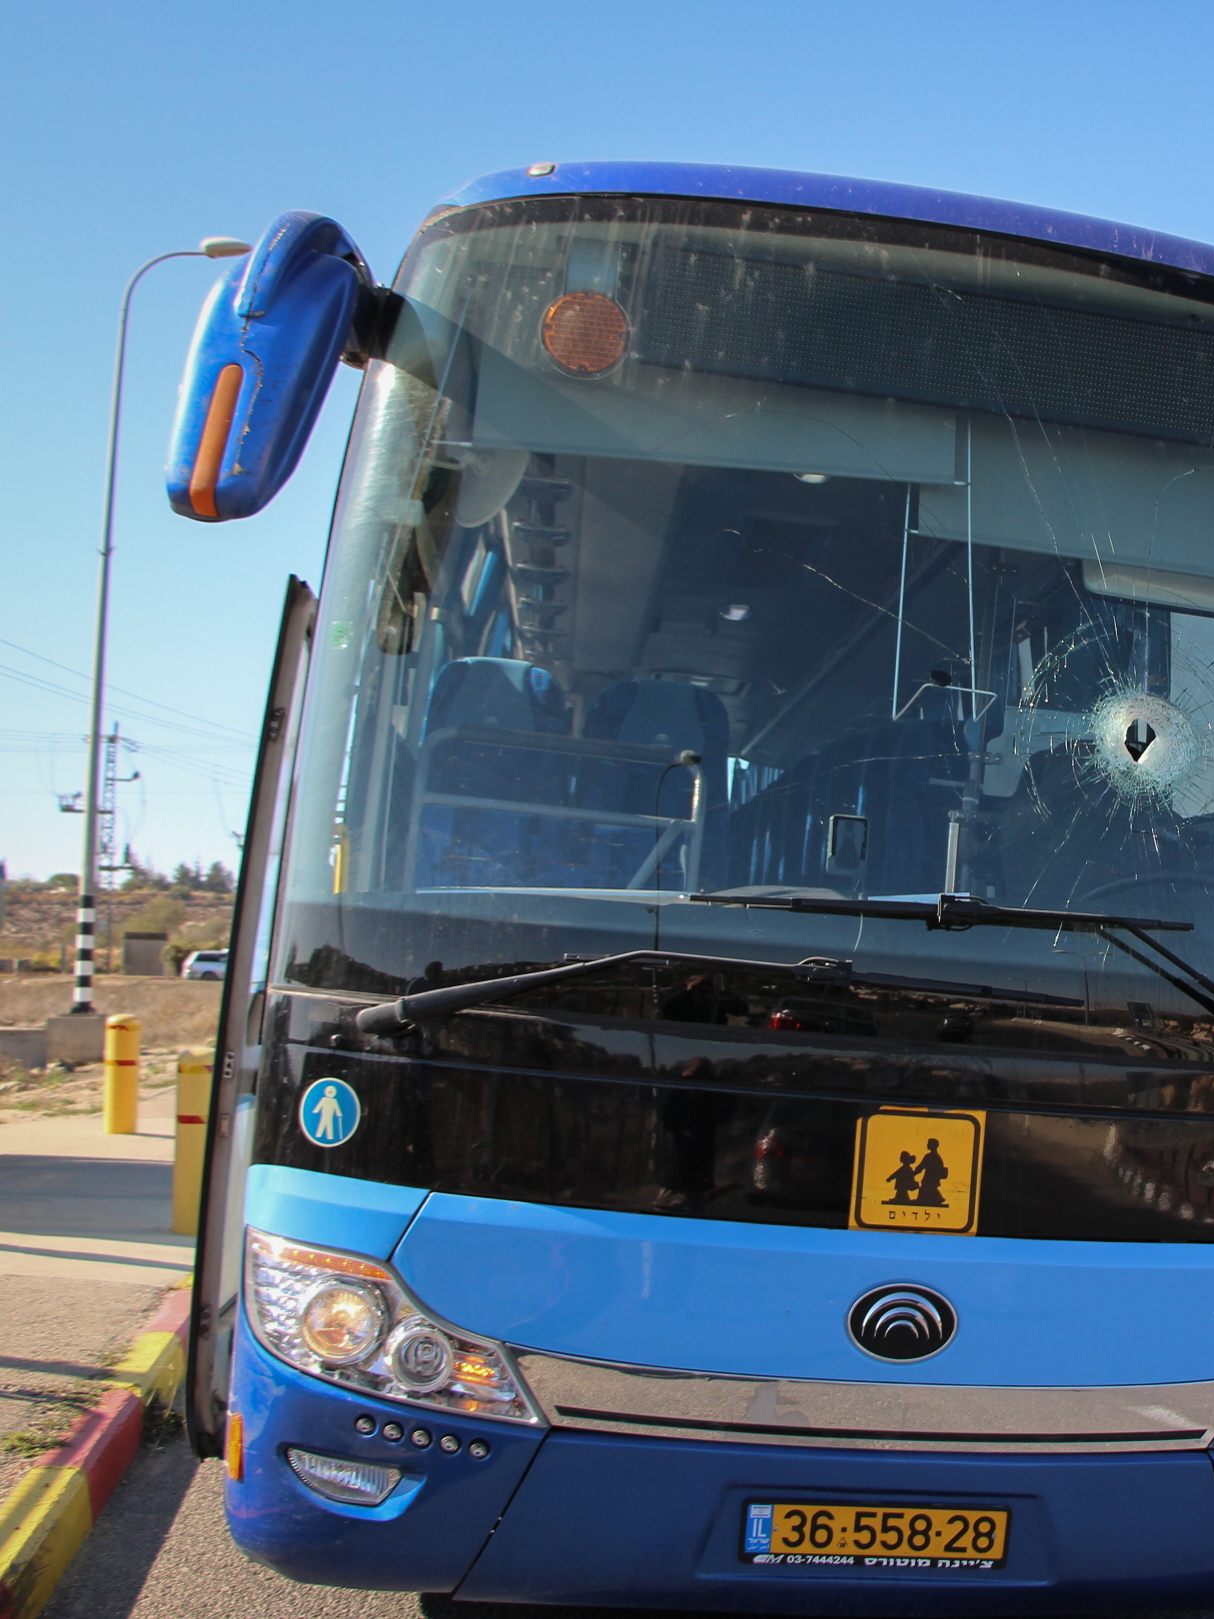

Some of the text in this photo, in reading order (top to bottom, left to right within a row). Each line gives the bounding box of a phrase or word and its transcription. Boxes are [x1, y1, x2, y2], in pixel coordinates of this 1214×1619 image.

[889, 1209, 941, 1221] ילדים
[752, 1518, 767, 1537] IL
[786, 1555, 855, 1565] 03-7444244
[864, 1557, 931, 1567] מוטורס
